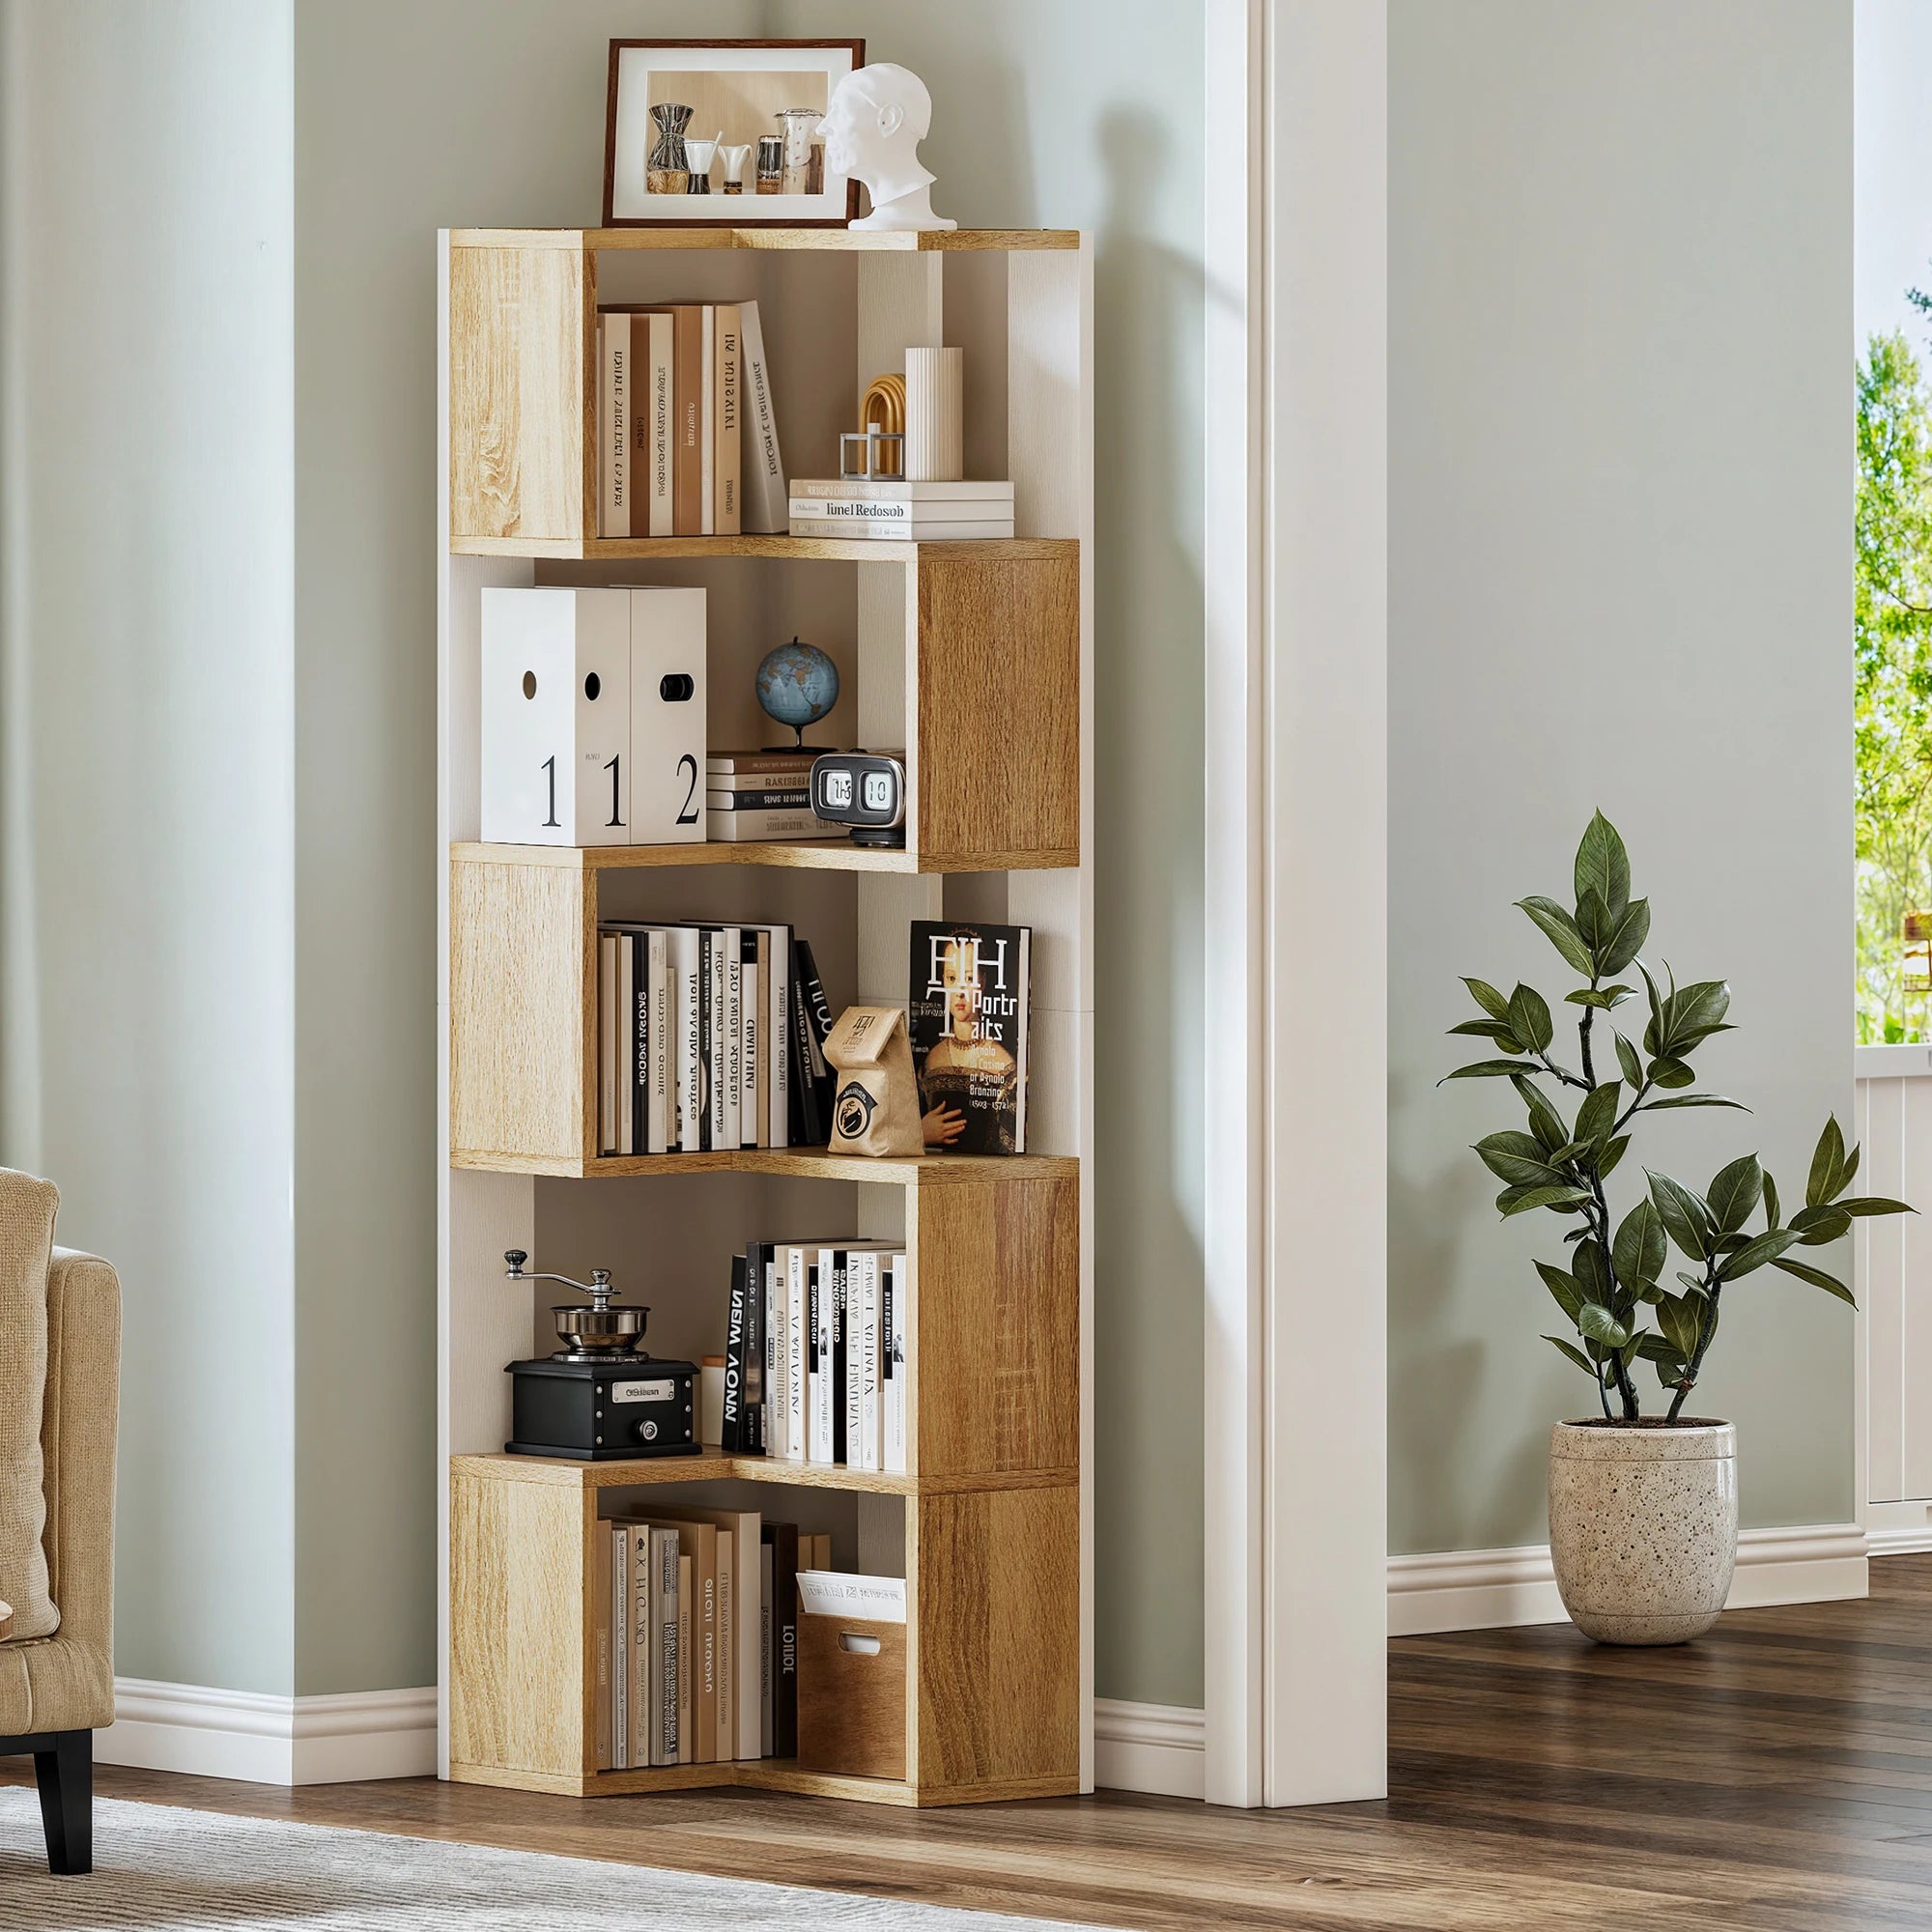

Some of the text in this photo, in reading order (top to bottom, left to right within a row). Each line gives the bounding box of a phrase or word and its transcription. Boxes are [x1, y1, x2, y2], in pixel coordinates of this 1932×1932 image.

[541, 754, 561, 827] 1
[603, 753, 627, 827] 1
[675, 753, 699, 825] 2
[970, 1015, 1004, 1041] aits
[972, 989, 1017, 1015] Portr
